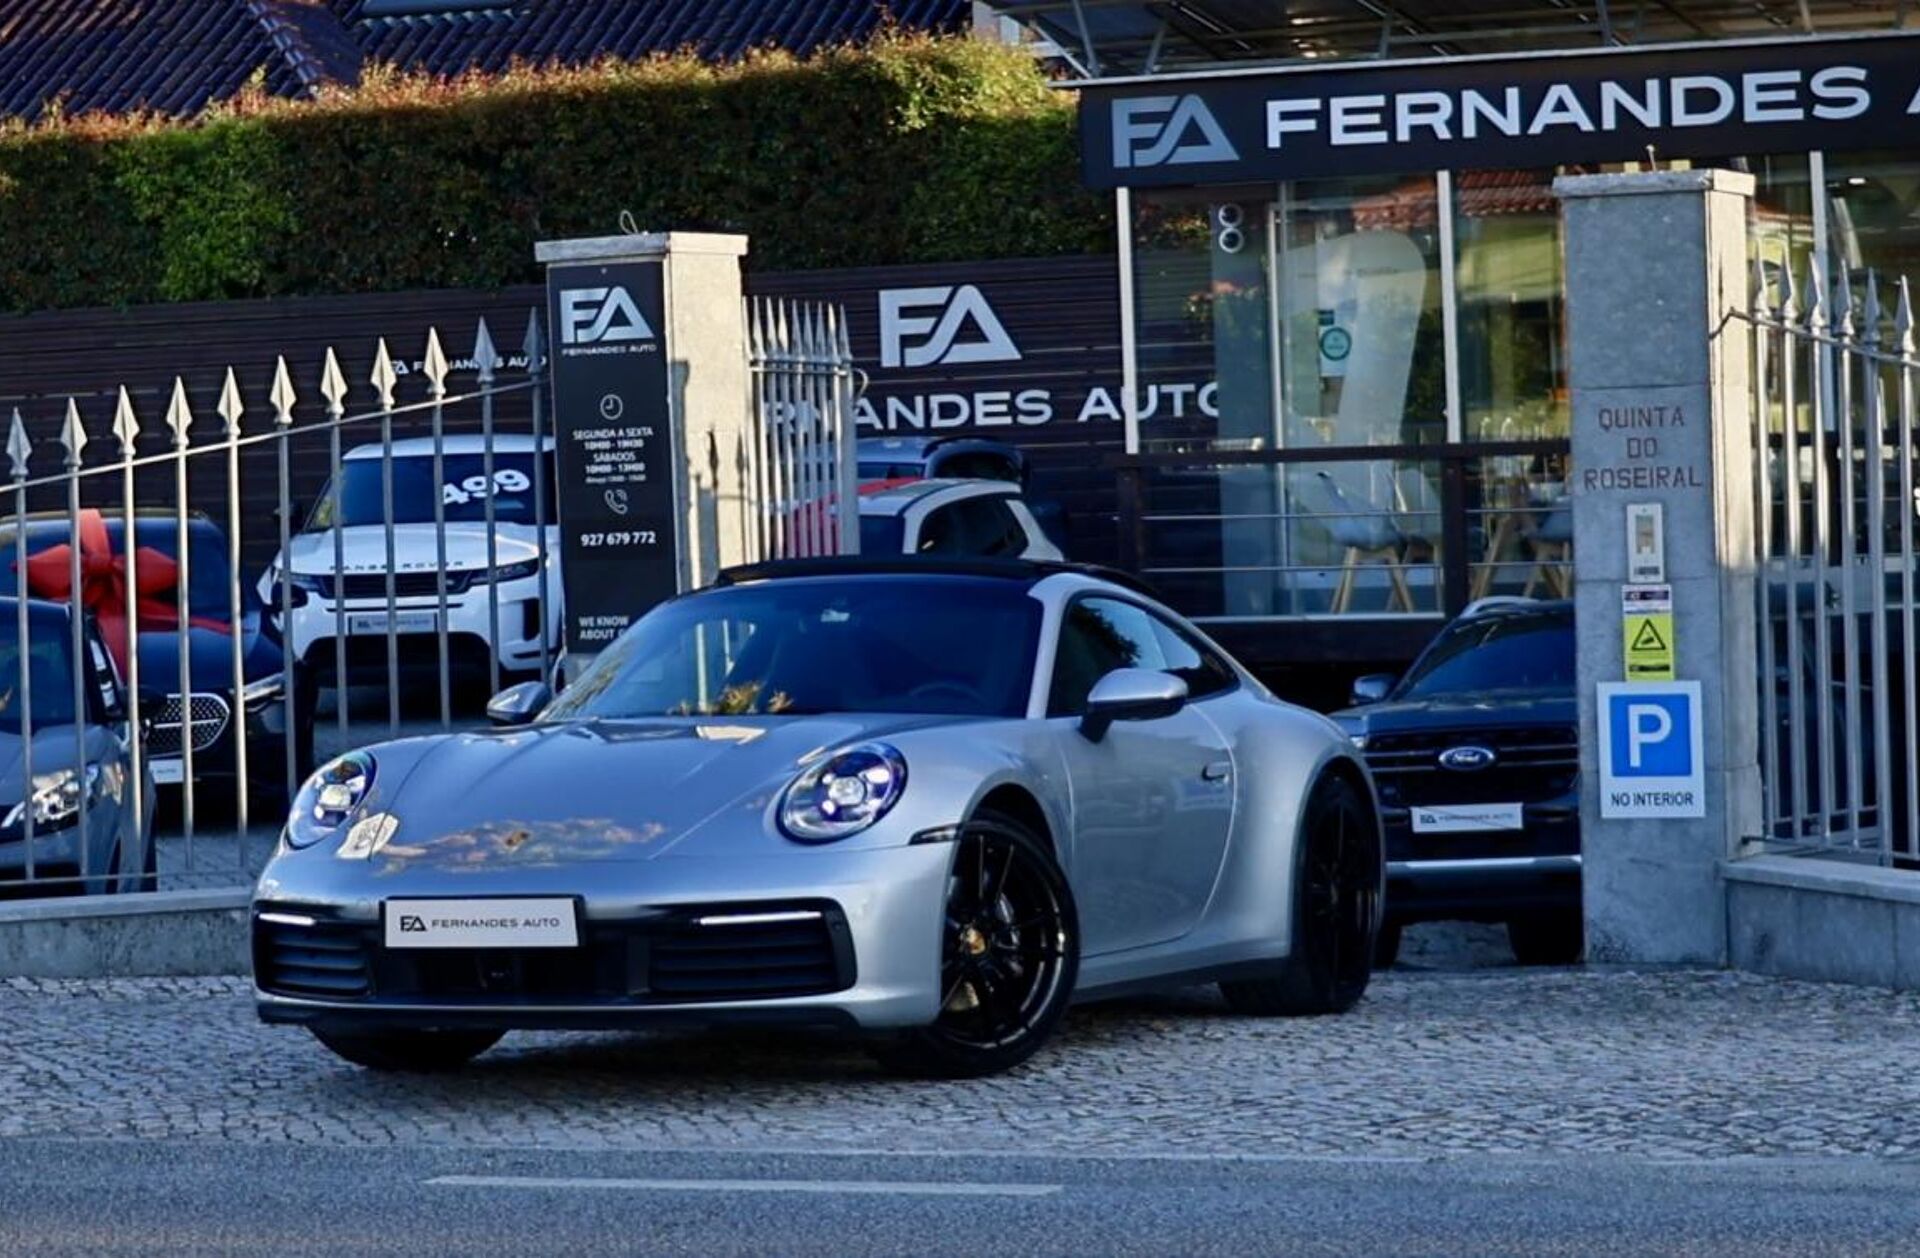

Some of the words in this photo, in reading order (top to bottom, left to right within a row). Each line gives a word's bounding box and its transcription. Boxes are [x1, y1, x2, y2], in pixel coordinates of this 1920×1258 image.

[1111, 94, 1240, 168] FA
[1266, 66, 1871, 148] FERNANDES
[559, 286, 655, 344] FA
[879, 284, 1022, 368] FA
[1598, 406, 1685, 432] QUINTA
[572, 430, 616, 441] SEGUNDA
[1627, 437, 1659, 459] DO
[1583, 465, 1703, 491] ROSEIRAL
[580, 533, 603, 546] 927
[606, 532, 630, 545] 679
[632, 530, 656, 544] 772
[579, 616, 595, 627] WE
[597, 615, 629, 626] KNOW
[580, 628, 615, 640] ABOUT
[1628, 703, 1673, 768] P
[1611, 793, 1630, 807] NO
[1633, 791, 1694, 806] INTERIOR
[431, 917, 519, 929] FERNANDES
[523, 917, 561, 928] AUTO
